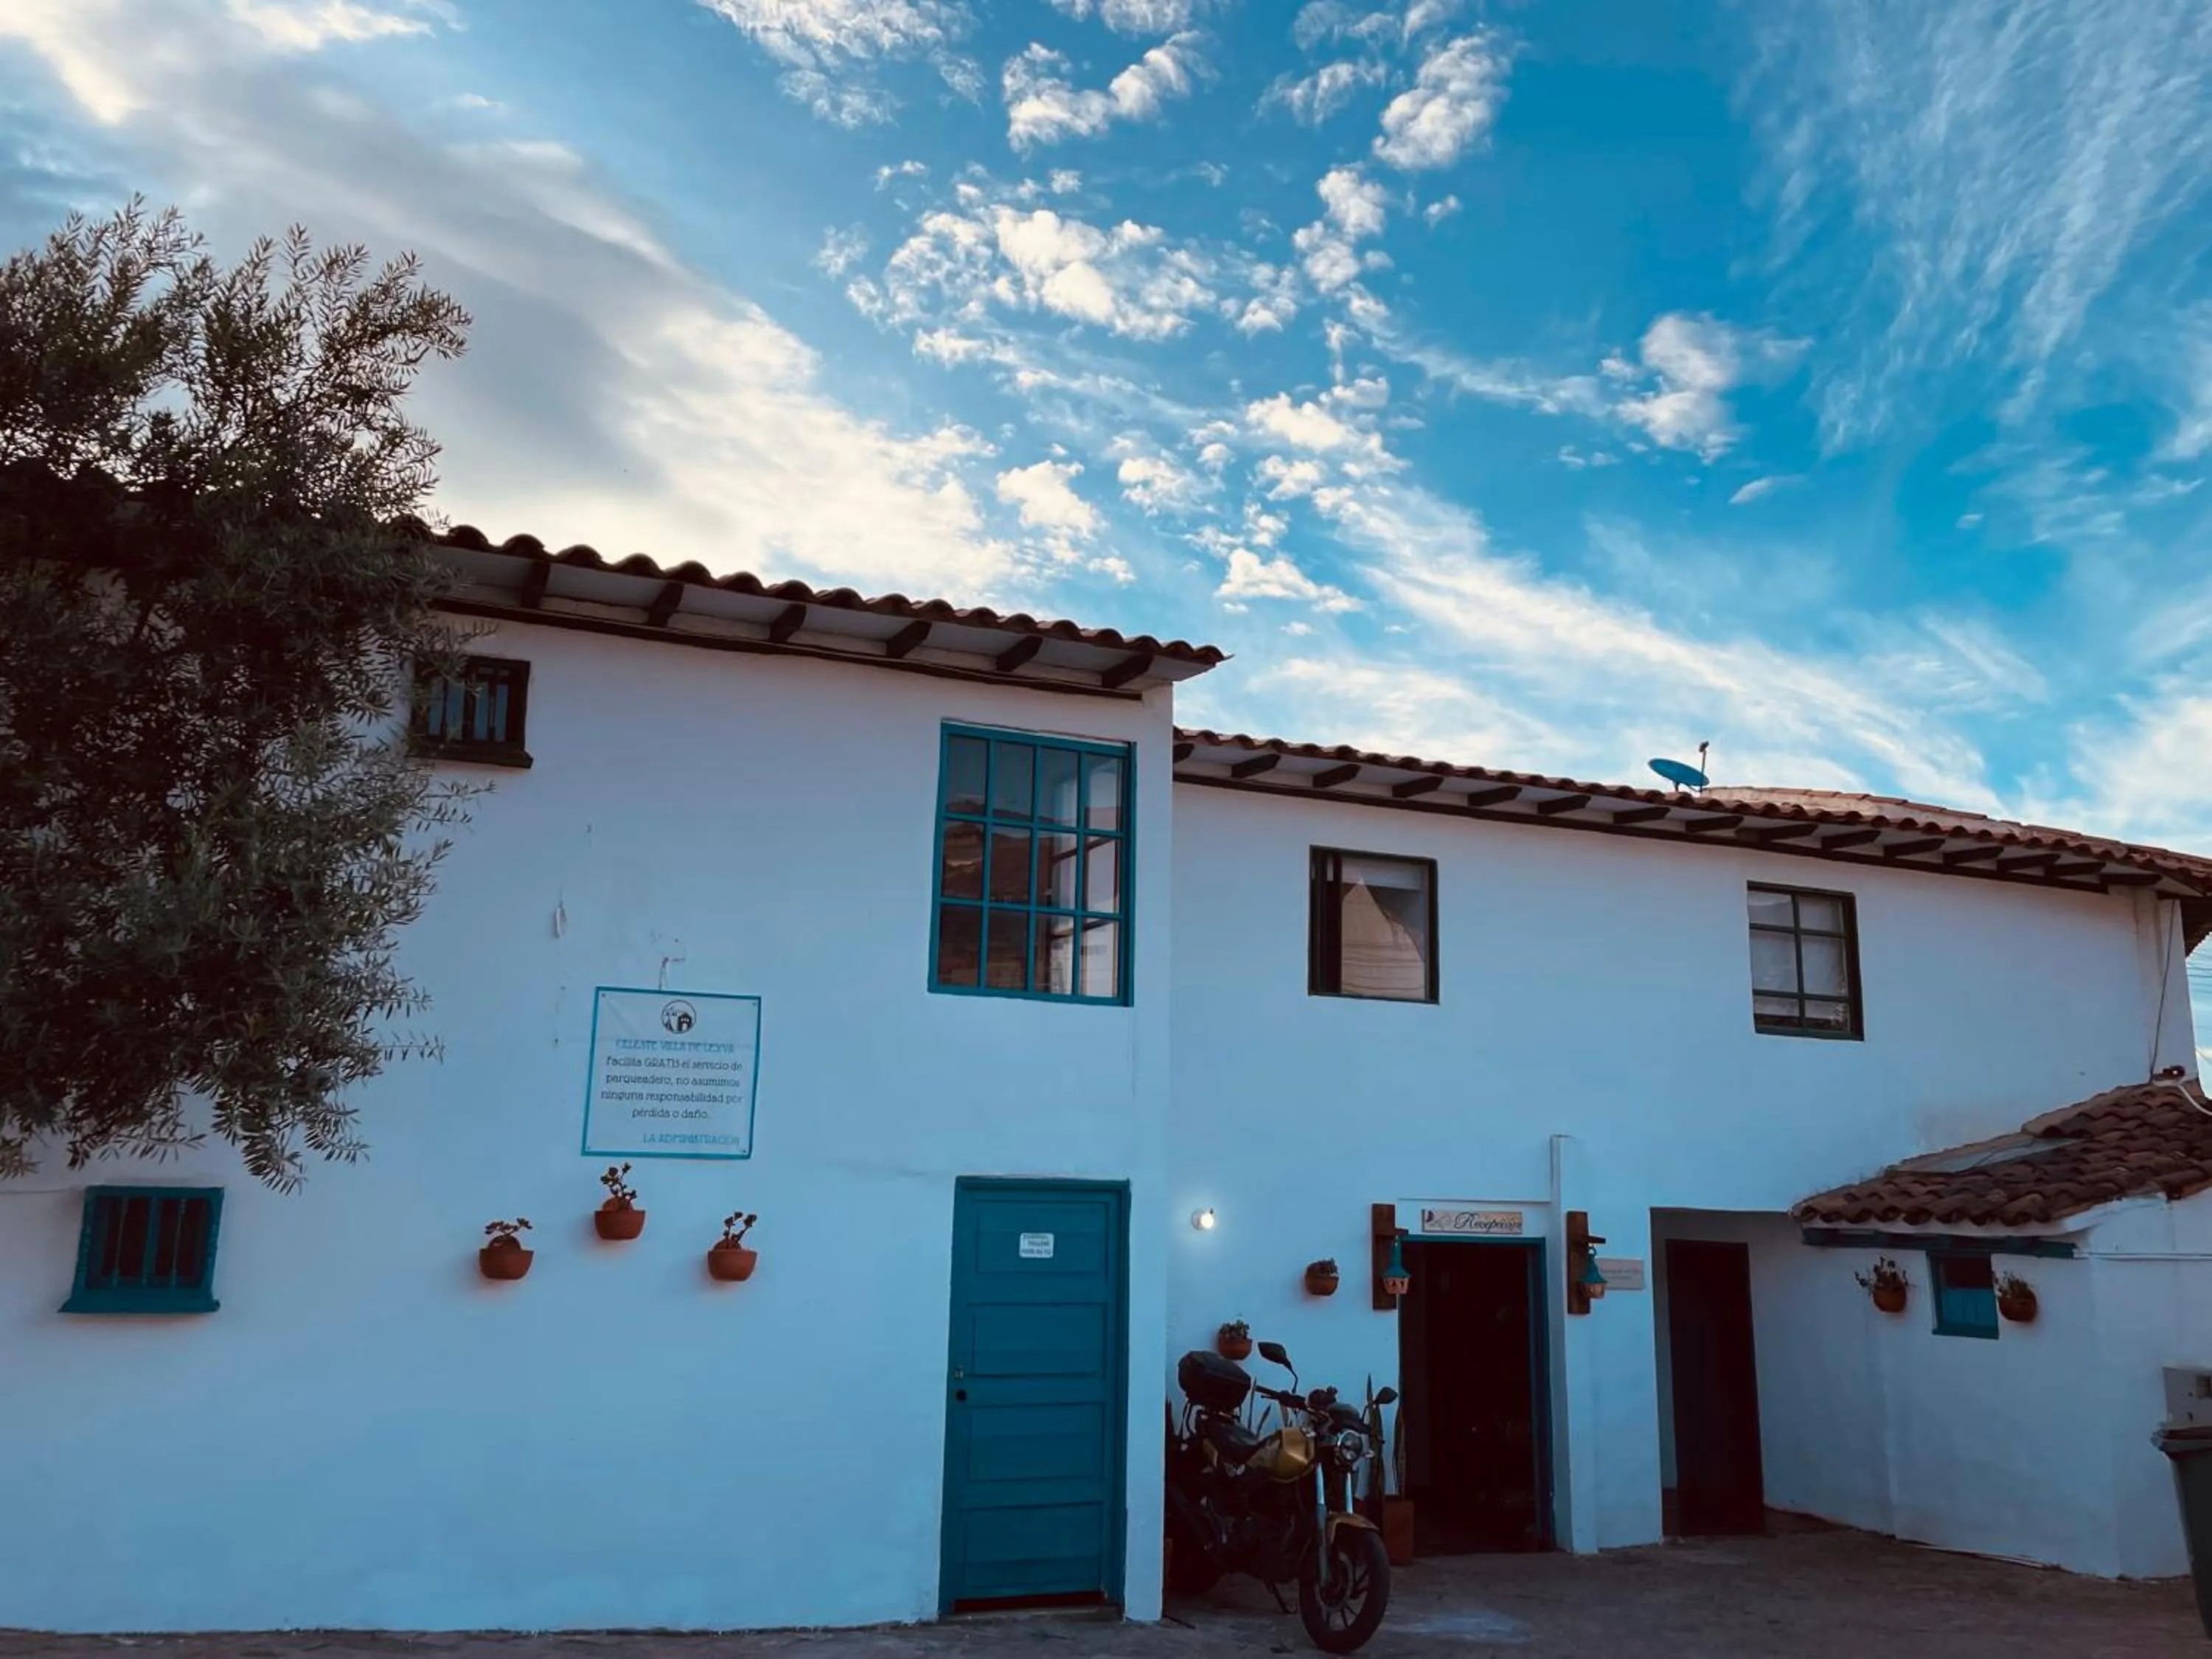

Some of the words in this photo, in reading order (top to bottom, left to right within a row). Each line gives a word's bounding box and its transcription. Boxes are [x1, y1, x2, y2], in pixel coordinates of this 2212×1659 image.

[644, 1057, 680, 1068] GRATIS
[692, 1060, 729, 1070] servicio
[731, 1062, 742, 1071] de
[676, 1077, 690, 1085] no
[692, 1077, 740, 1087] asumimos
[601, 1091, 644, 1101] ninguna
[645, 1091, 723, 1104] responsabilidad
[726, 1095, 744, 1105] por
[672, 1110, 680, 1119] o
[642, 1132, 655, 1144] LA
